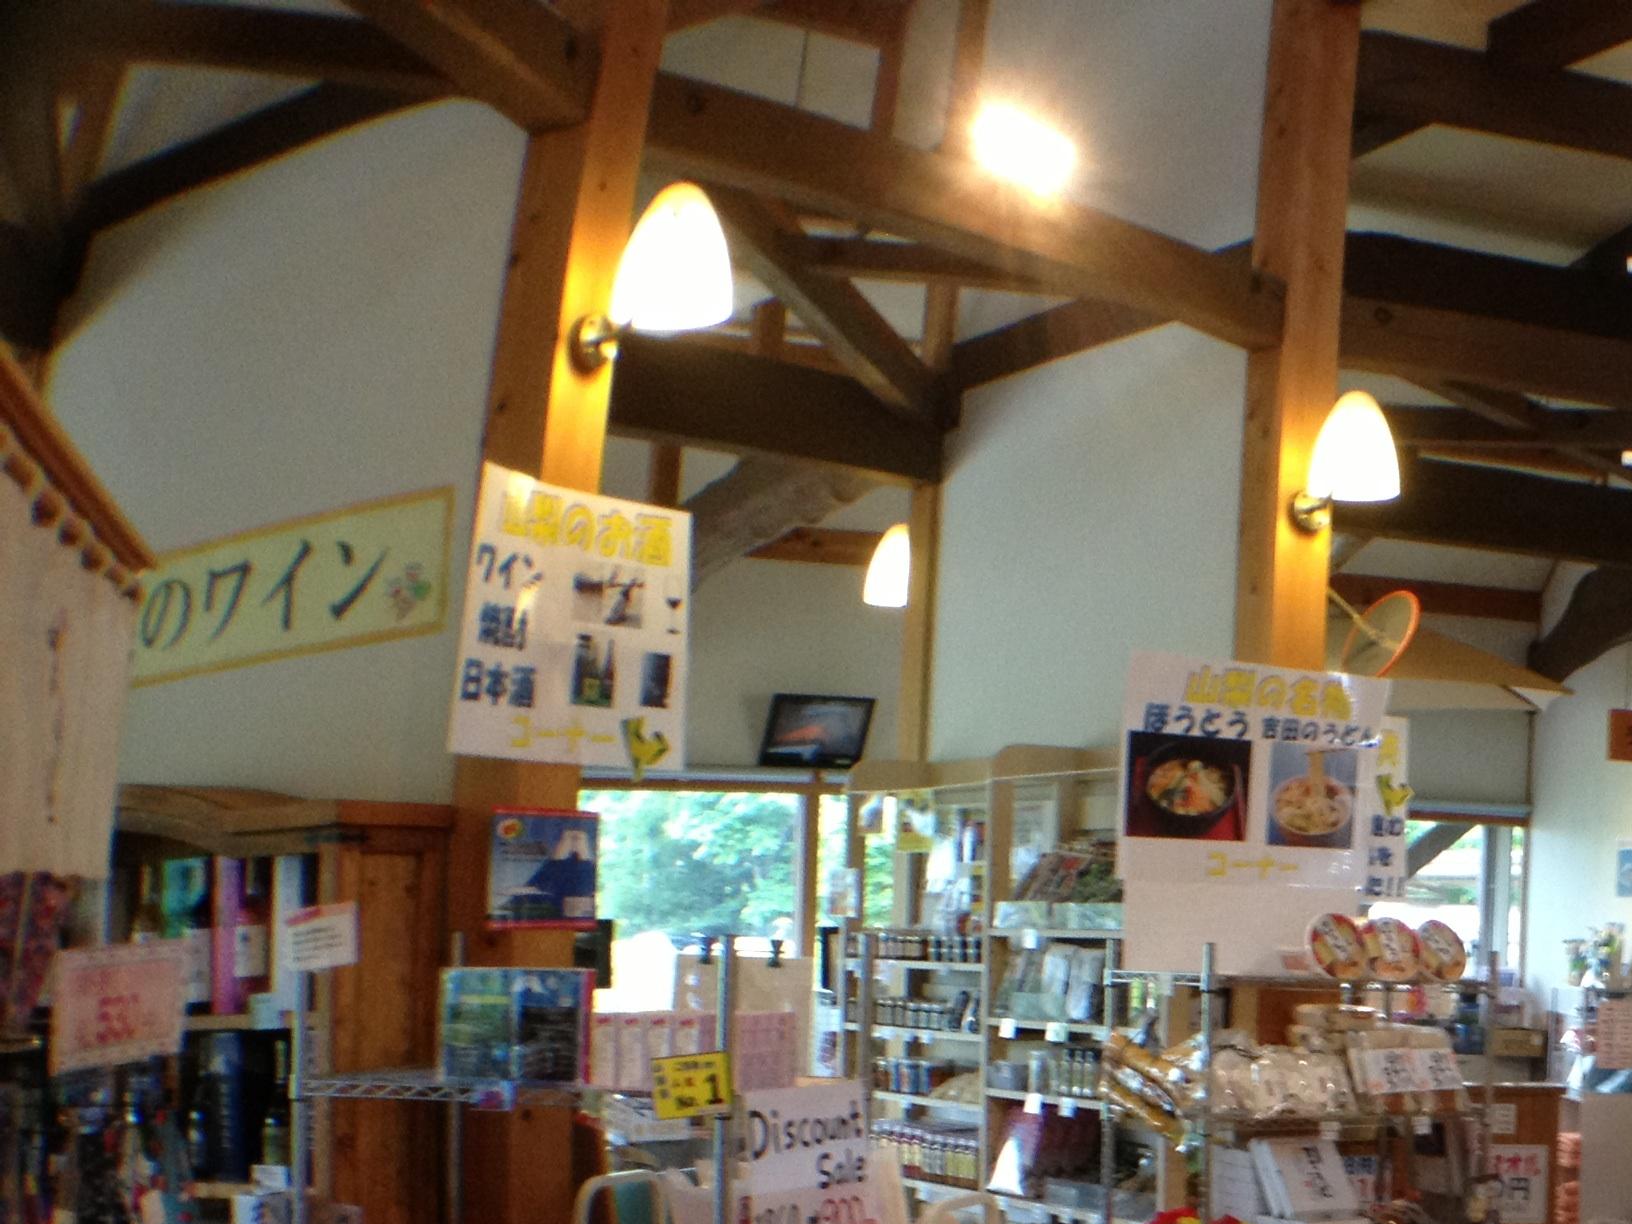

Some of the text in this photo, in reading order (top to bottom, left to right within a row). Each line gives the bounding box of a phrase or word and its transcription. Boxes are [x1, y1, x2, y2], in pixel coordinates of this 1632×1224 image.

[476, 543, 544, 590] ワイン
[139, 538, 391, 652] のワイン
[460, 657, 537, 709] 日本酒
[510, 715, 616, 752] コーナー
[1143, 702, 1250, 739] ほうとう
[1204, 852, 1298, 878] コーナー
[749, 1101, 864, 1161] Discount
[816, 1149, 866, 1190] Sale
